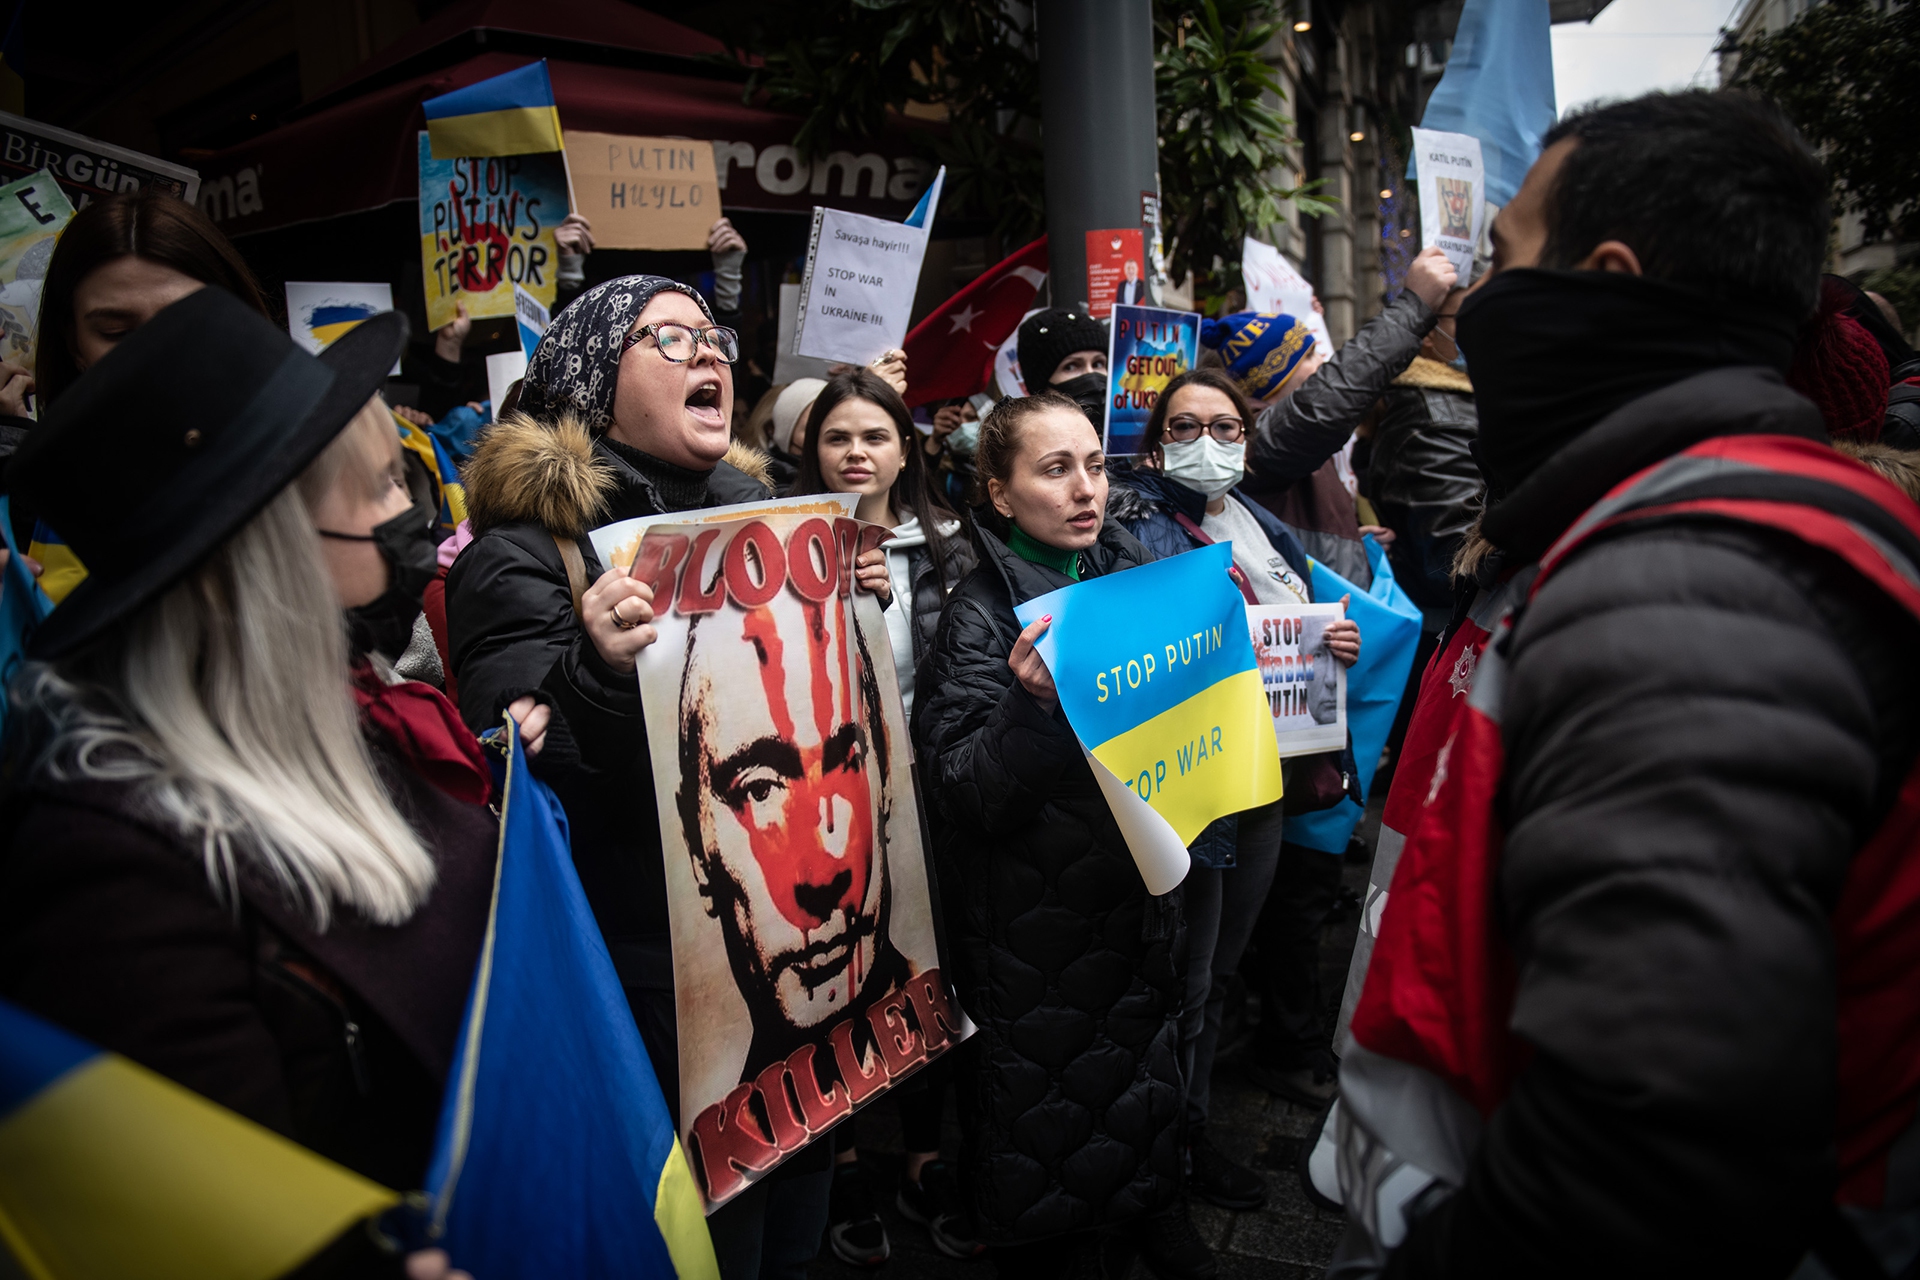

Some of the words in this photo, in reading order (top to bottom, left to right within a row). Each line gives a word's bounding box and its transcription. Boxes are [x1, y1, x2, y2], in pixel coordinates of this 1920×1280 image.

[608, 144, 695, 172] PUTIN
[454, 156, 521, 197] STOP
[834, 229, 870, 246] Savaşa
[434, 243, 548, 297] TERROR
[827, 267, 856, 281] STOP
[858, 273, 883, 287] WAR
[824, 284, 837, 297] İN
[821, 304, 868, 323] UKRAİNE
[1120, 318, 1181, 344] PUTIN
[1126, 354, 1152, 375] GET
[1154, 356, 1177, 376] OUT
[1113, 387, 1129, 409] of
[1262, 617, 1303, 646] STOP
[1096, 652, 1156, 704] STOP
[1164, 623, 1223, 673] PUTIN
[1176, 725, 1223, 777] WAR
[691, 967, 962, 1203] KILLER
